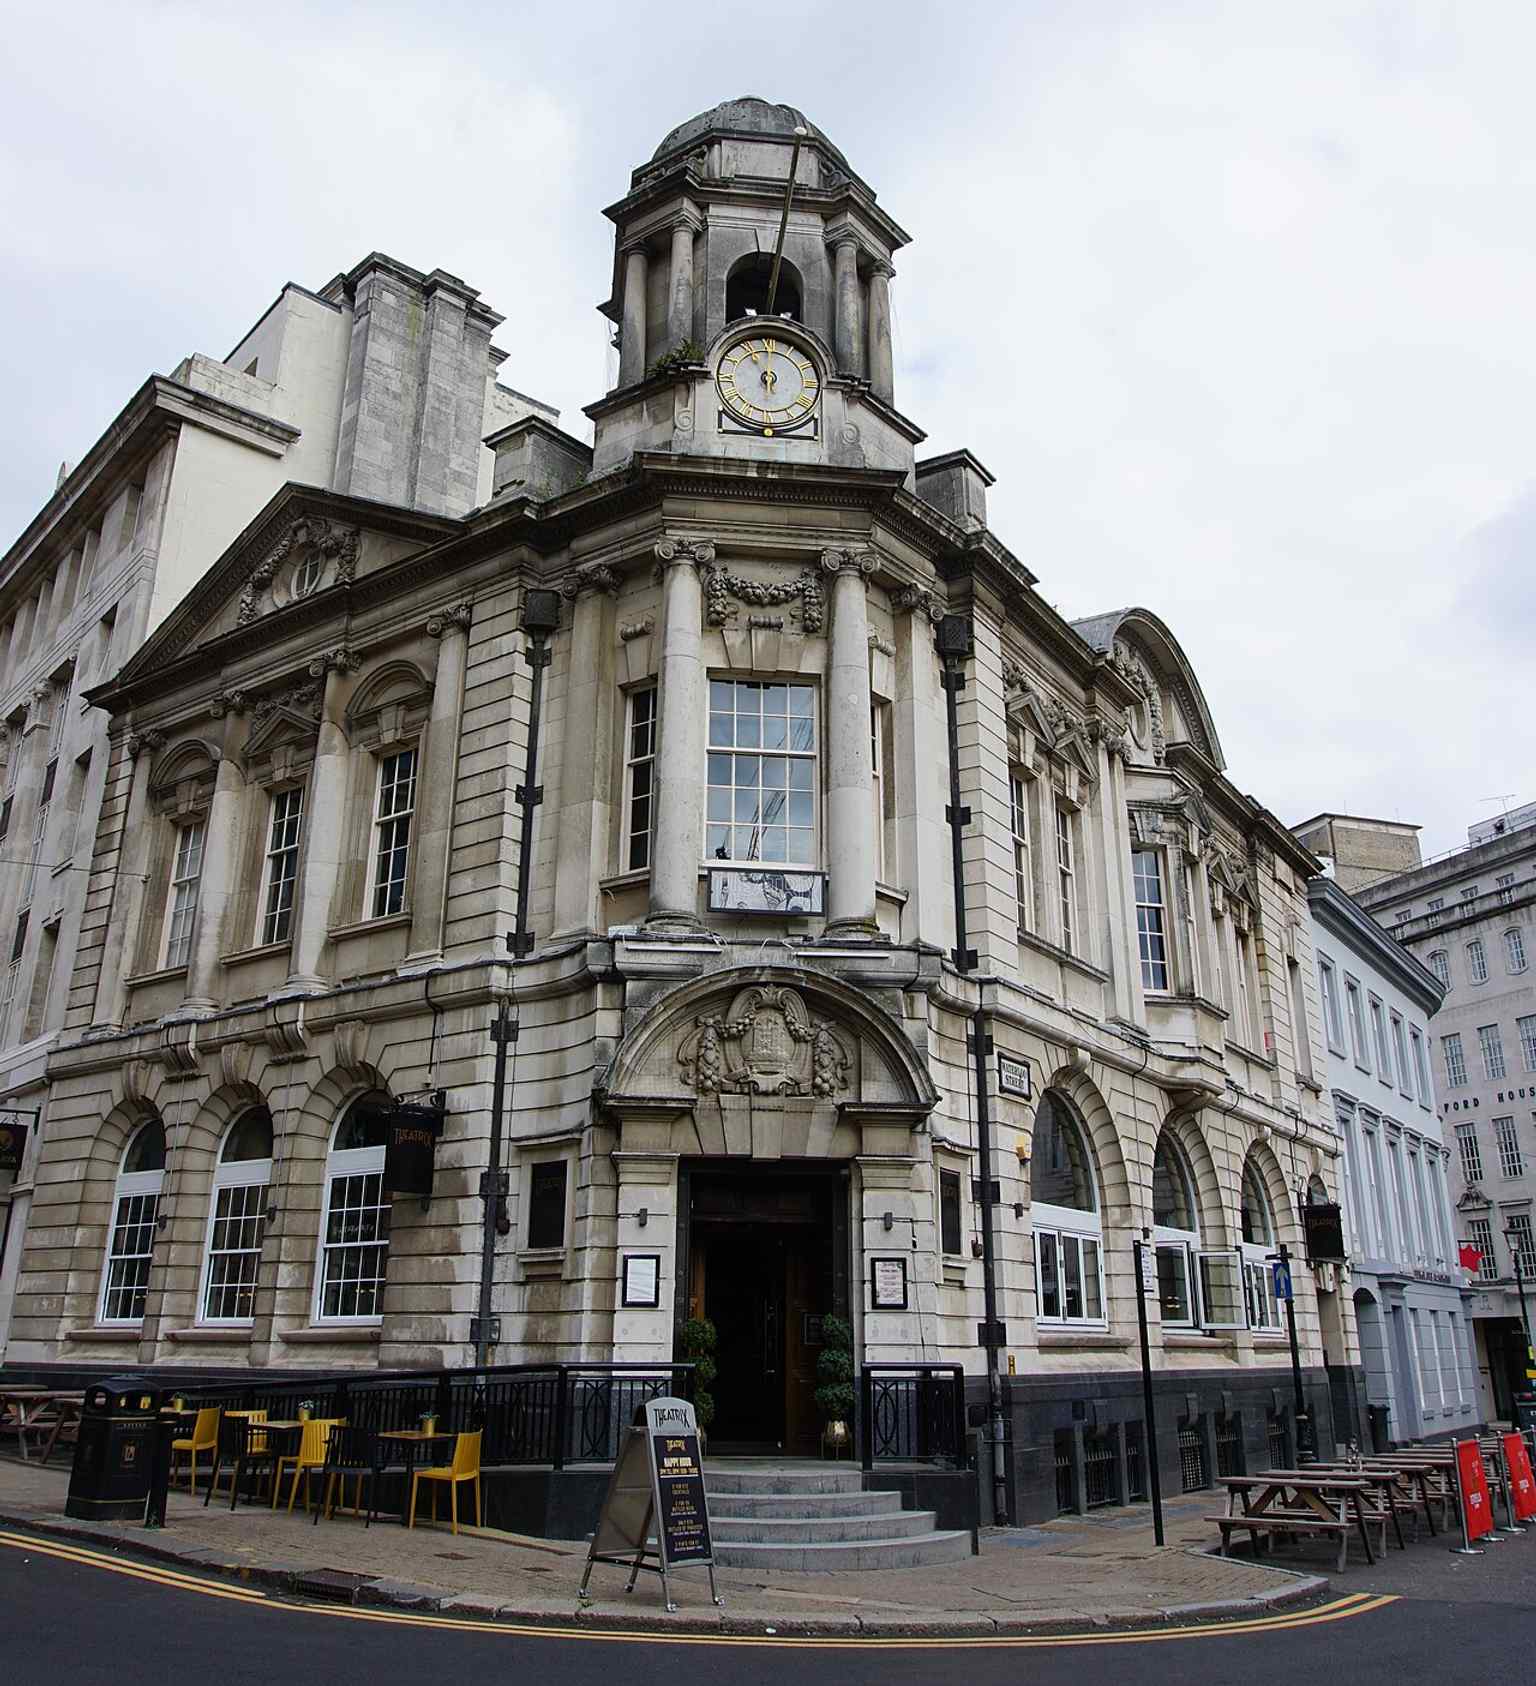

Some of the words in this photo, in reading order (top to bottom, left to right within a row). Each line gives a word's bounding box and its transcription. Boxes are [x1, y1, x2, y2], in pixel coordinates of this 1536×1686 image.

[803, 379, 818, 388] III
[1005, 1073, 1025, 1090] STREET
[654, 1408, 690, 1428] THEATRIX
